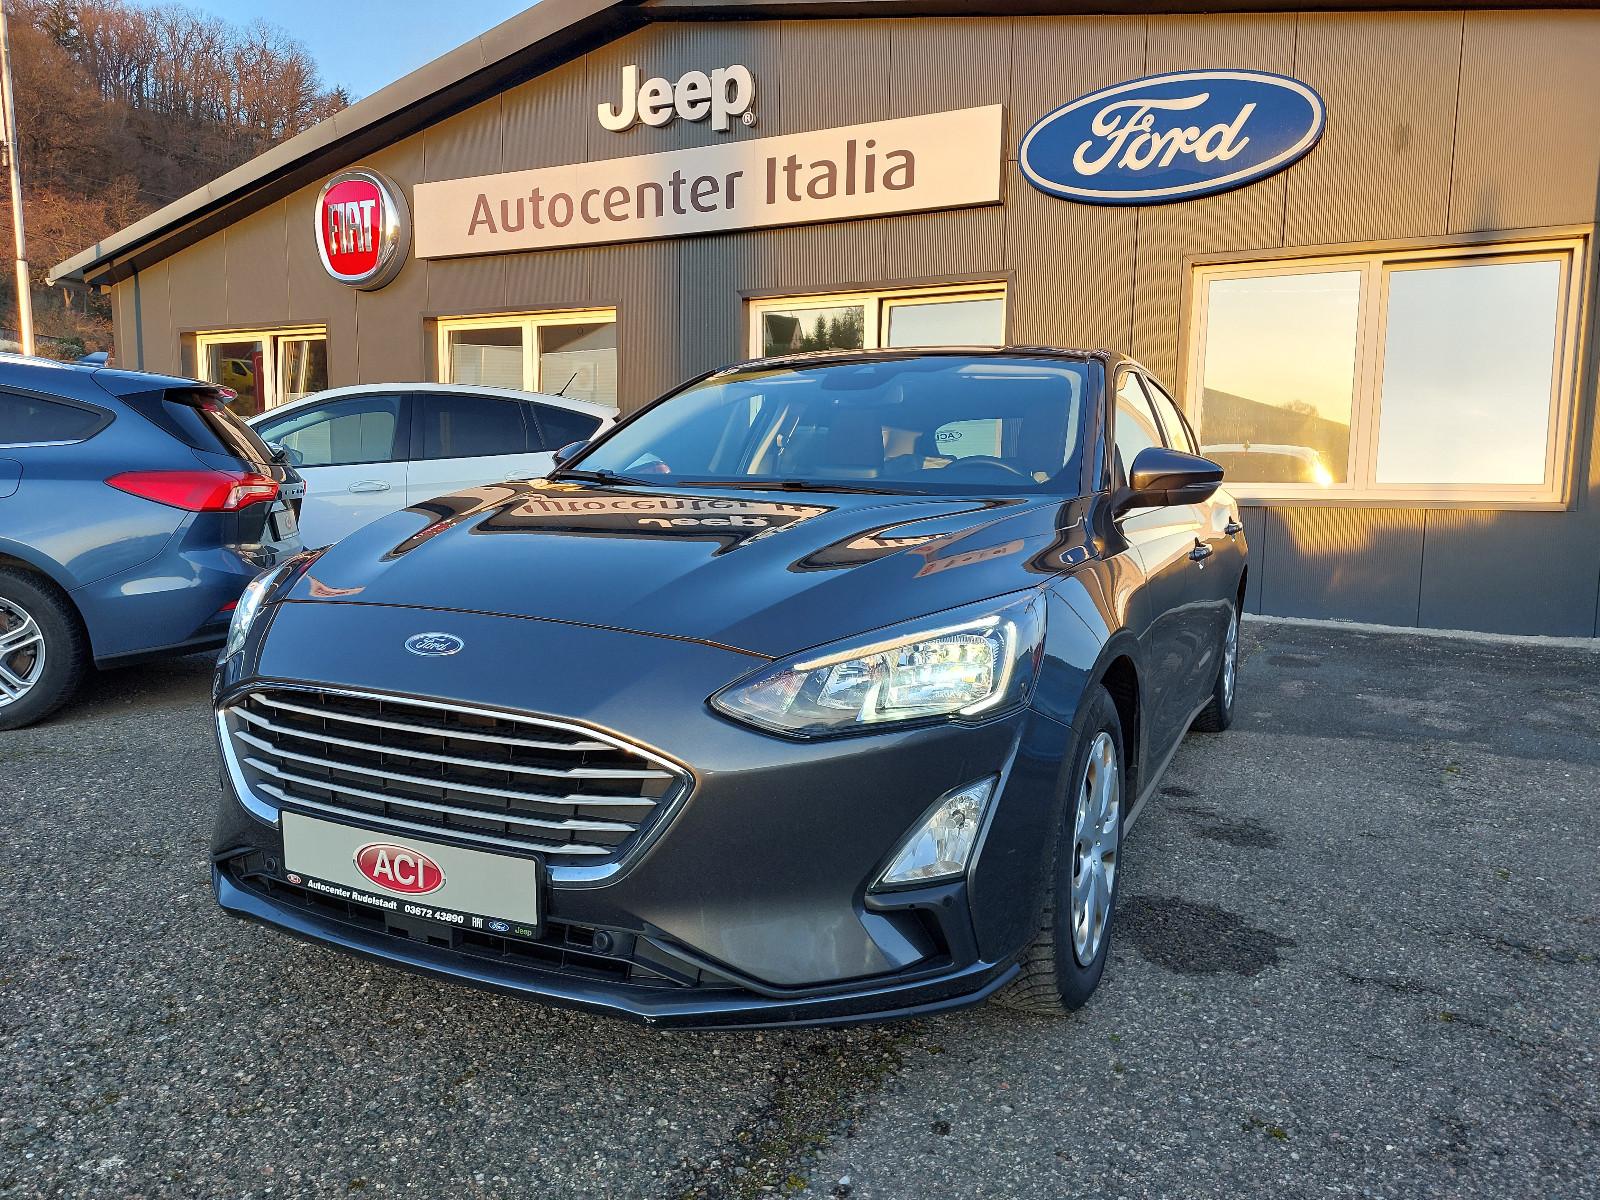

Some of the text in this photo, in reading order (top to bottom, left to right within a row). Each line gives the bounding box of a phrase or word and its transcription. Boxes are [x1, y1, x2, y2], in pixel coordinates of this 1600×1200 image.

[597, 63, 754, 131] Jeep
[1072, 92, 1257, 176] Ford
[468, 139, 915, 236] Autocenter Italia
[328, 199, 375, 255] FIAT
[415, 637, 451, 650] Ford
[372, 849, 425, 888] ACI
[307, 879, 465, 925] Autocenter Rudolstadt 03672 43890
